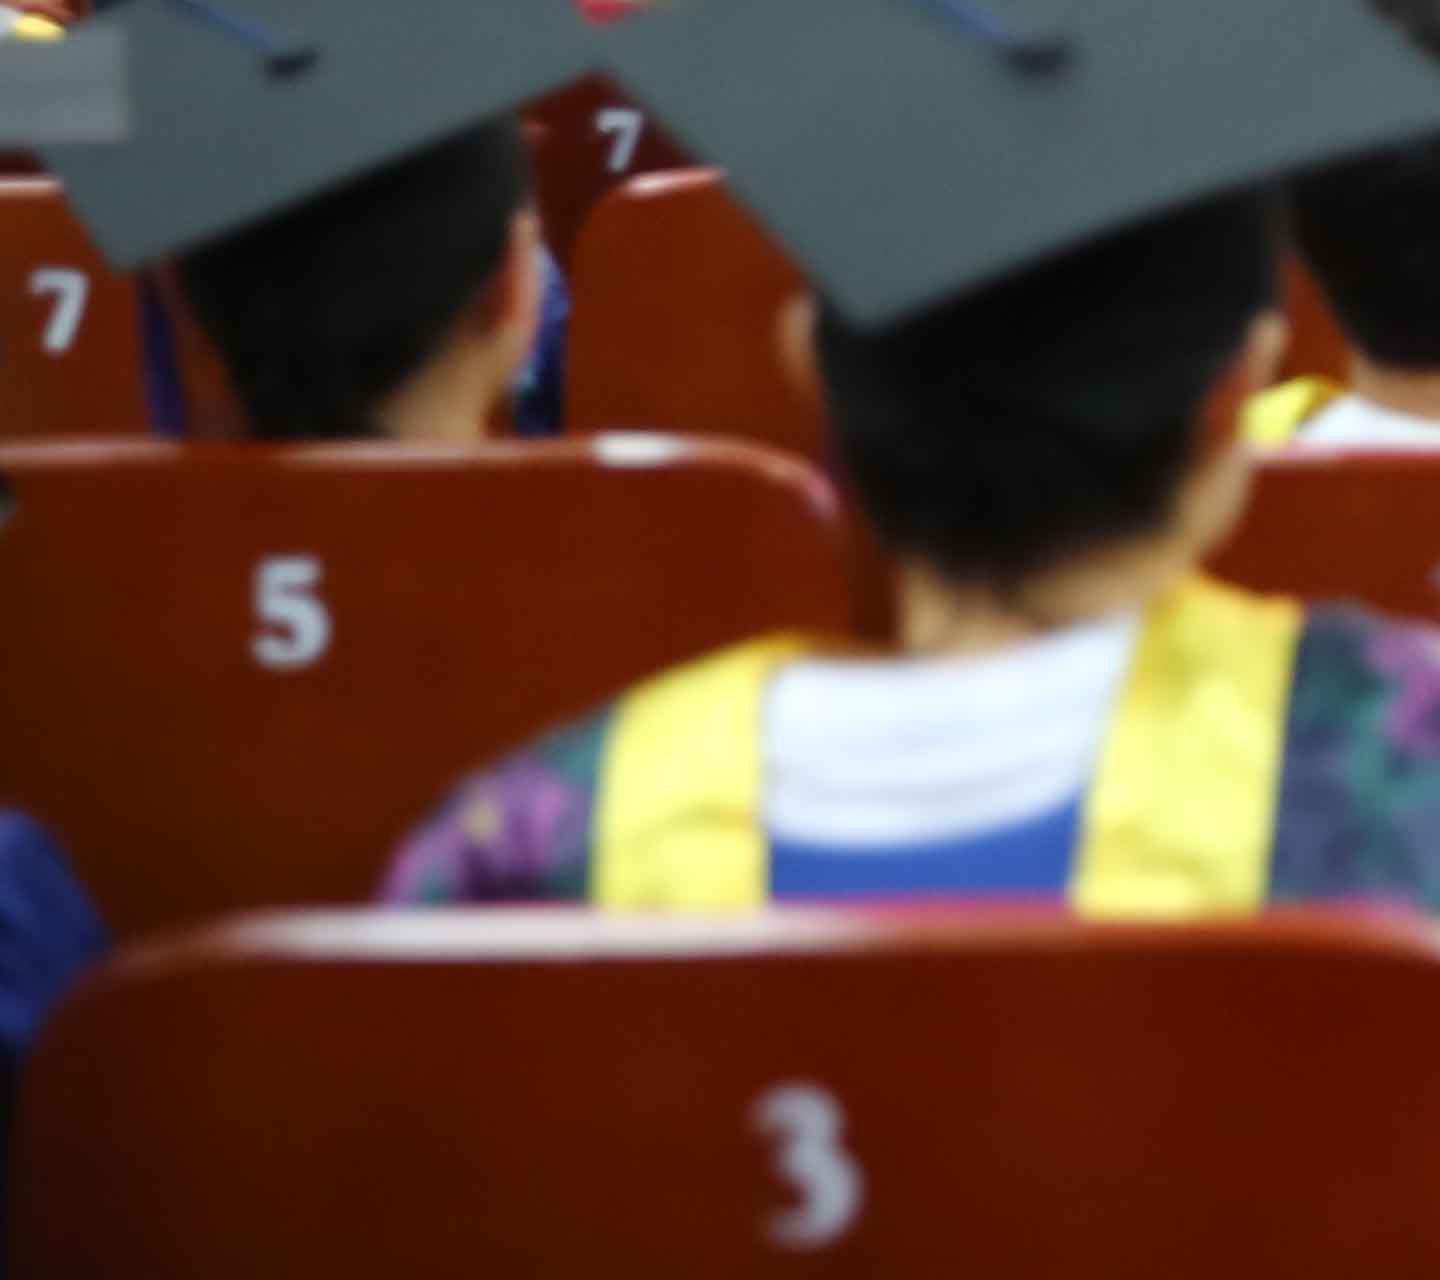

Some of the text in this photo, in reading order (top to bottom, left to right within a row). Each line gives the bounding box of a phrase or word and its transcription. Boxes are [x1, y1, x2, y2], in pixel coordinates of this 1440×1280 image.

[597, 109, 644, 170] 7
[30, 267, 89, 353] 7
[252, 555, 332, 668] 5
[752, 1082, 864, 1248] 3
